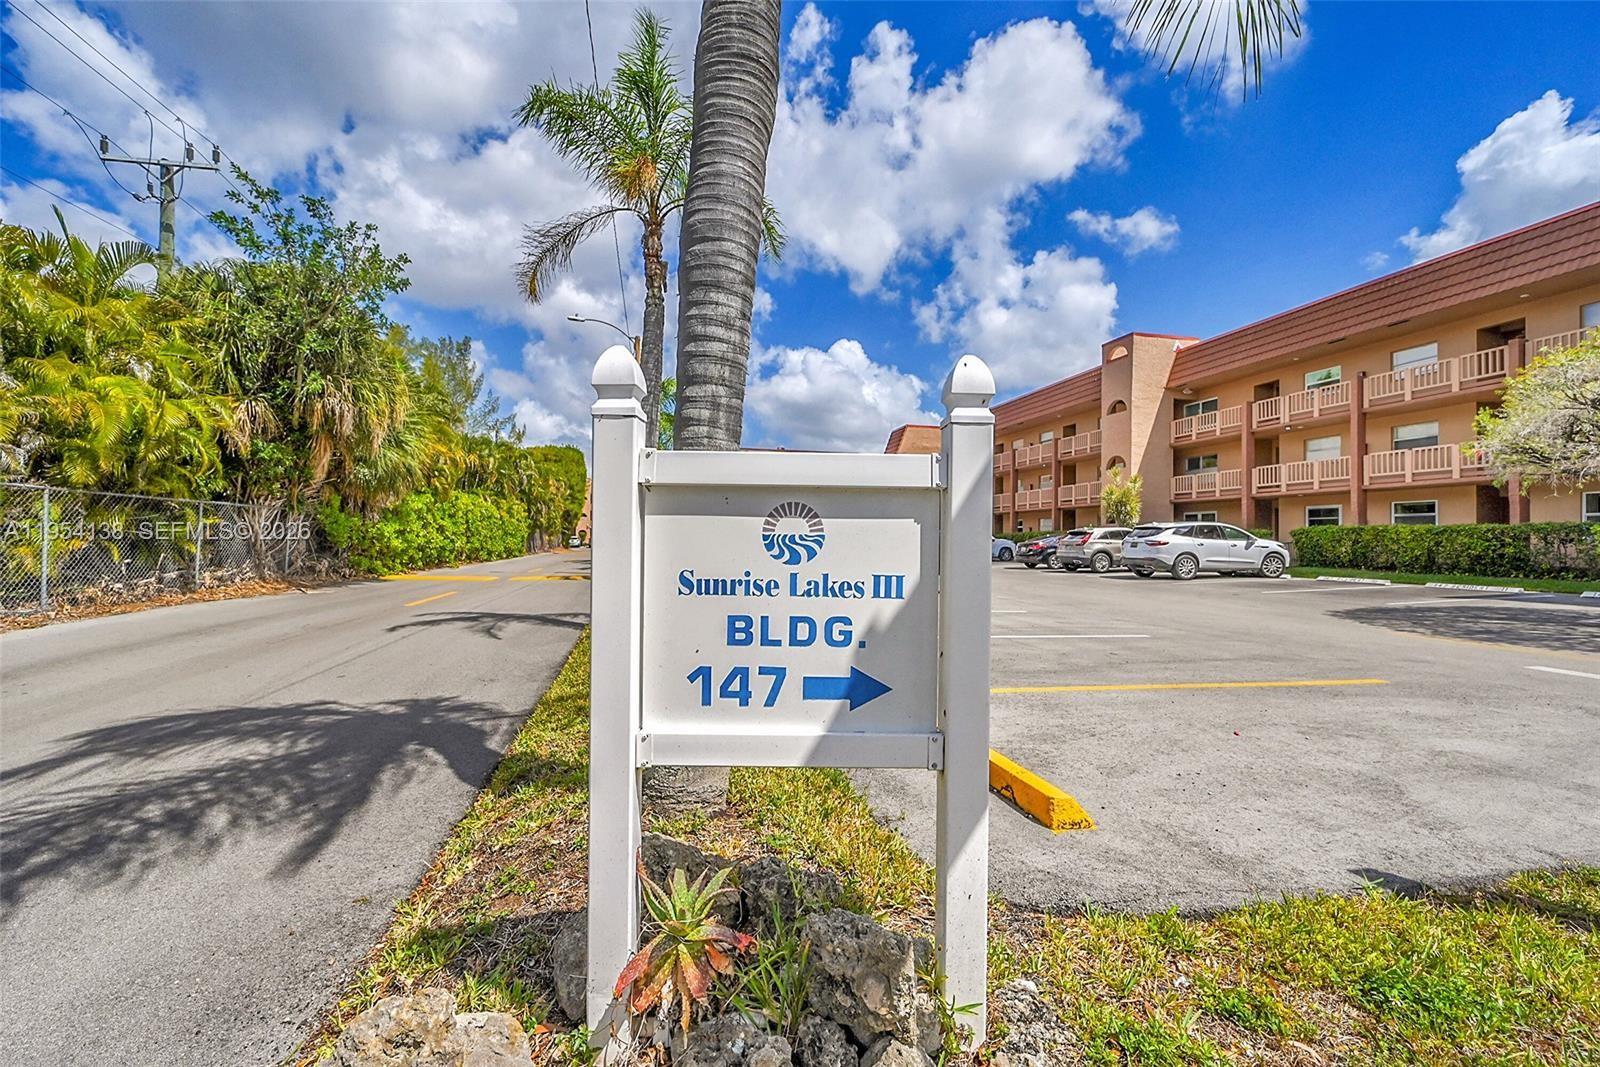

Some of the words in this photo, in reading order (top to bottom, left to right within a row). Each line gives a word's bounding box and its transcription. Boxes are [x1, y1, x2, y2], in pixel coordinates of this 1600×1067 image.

[677, 569, 780, 597] Sunrise
[788, 572, 866, 600] Lakes
[871, 574, 906, 600] III
[726, 614, 867, 649] BLDG.
[686, 665, 787, 708] 147
